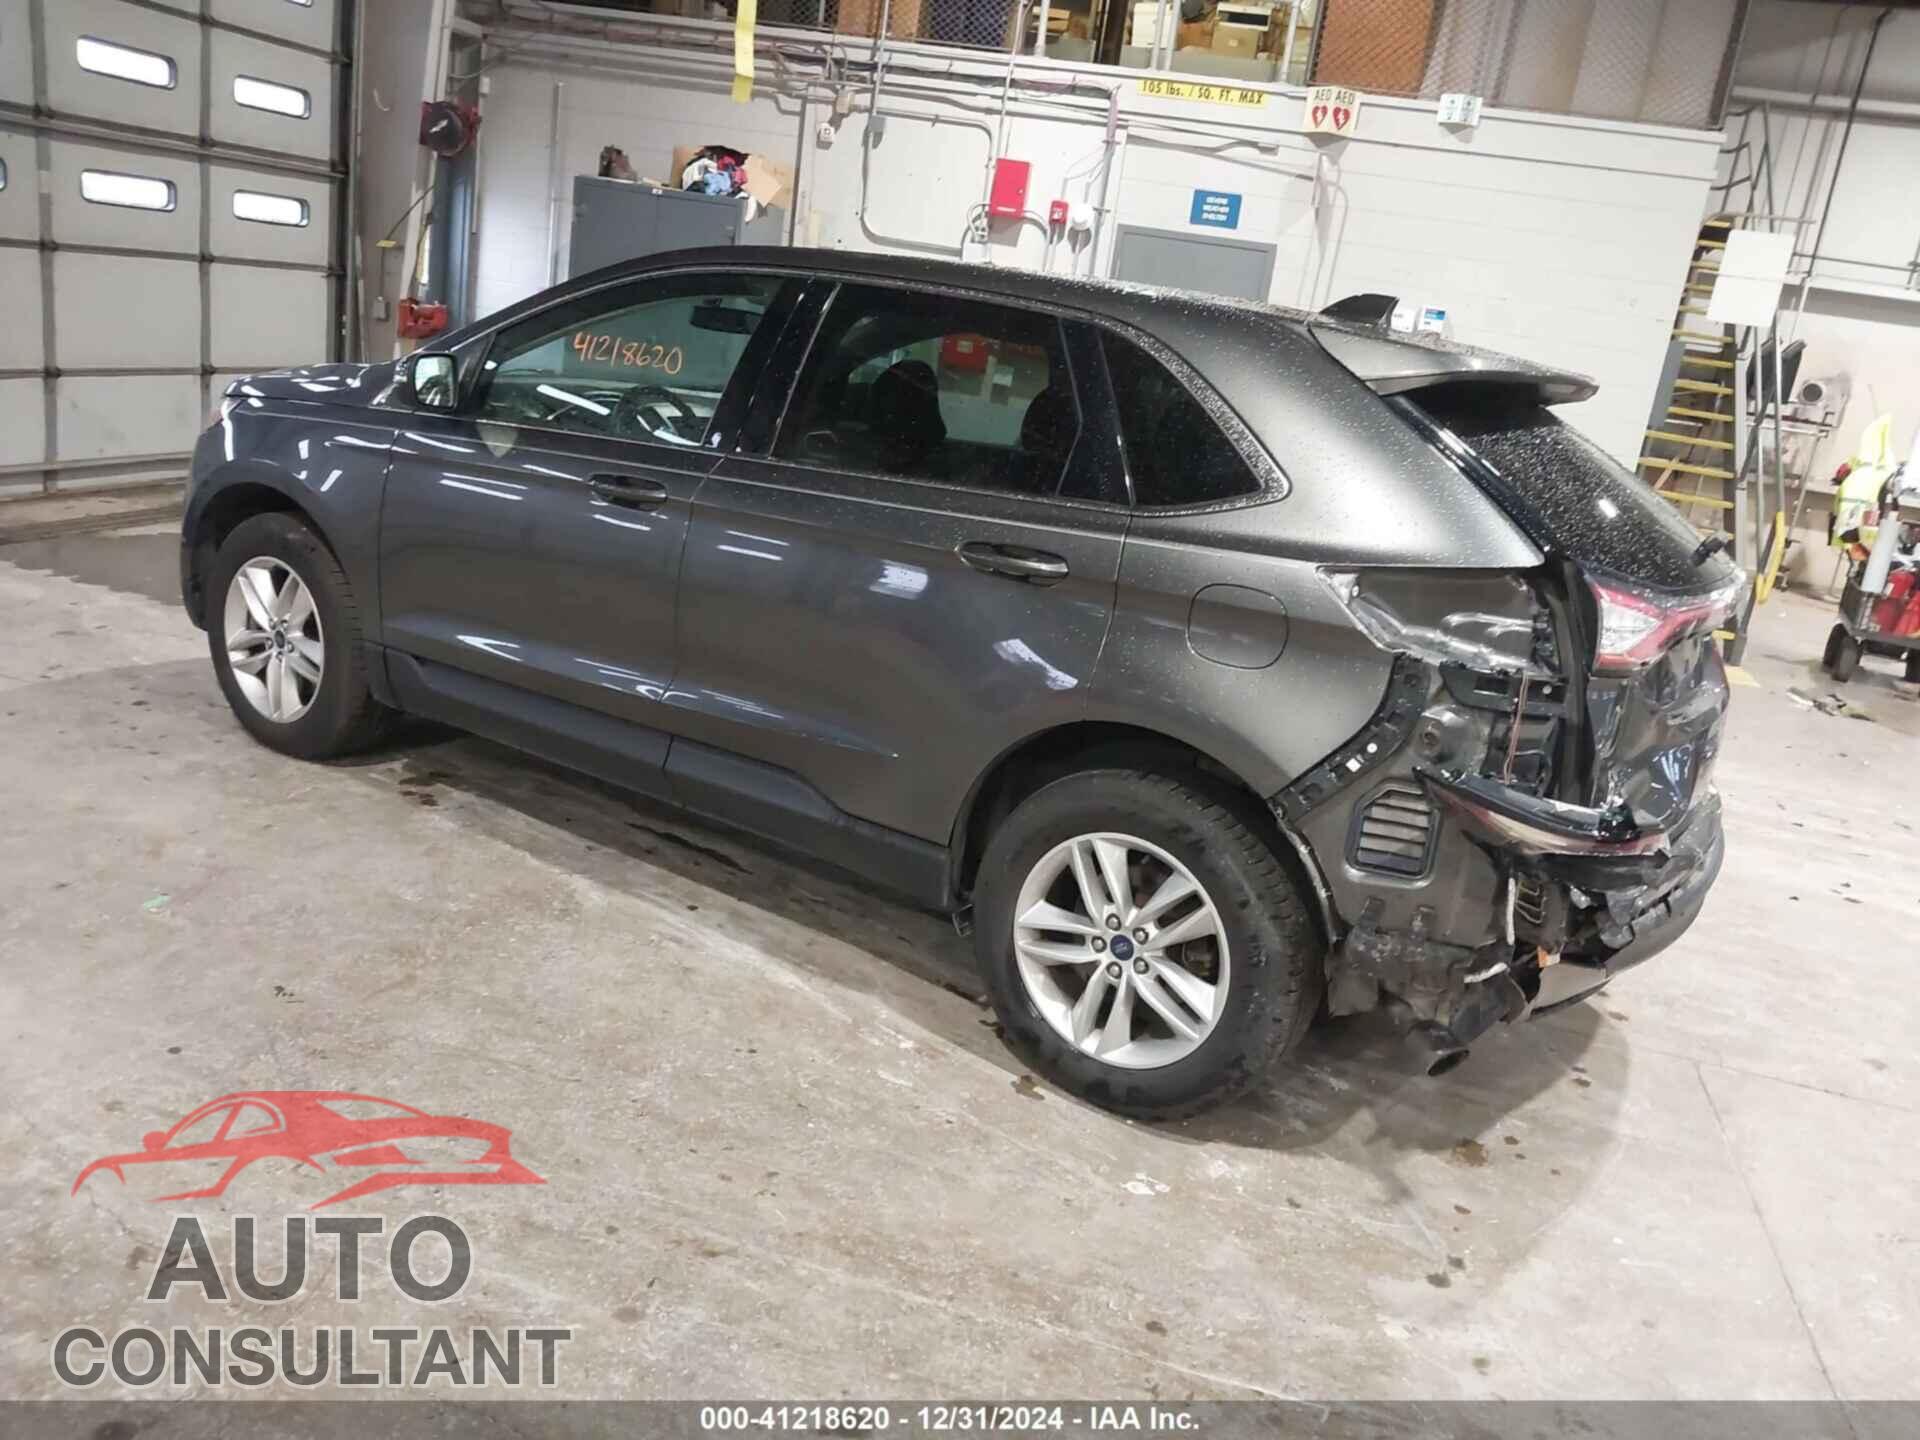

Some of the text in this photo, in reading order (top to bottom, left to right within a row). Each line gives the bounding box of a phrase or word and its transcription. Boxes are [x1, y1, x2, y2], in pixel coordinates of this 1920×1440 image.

[1142, 80, 1161, 94] 105
[1166, 80, 1184, 97] lbs.
[1198, 86, 1214, 100] SQ.
[1220, 88, 1234, 102] FT.
[1239, 90, 1264, 104] MAX
[1313, 88, 1331, 101] AED
[1334, 89, 1354, 105] AED
[574, 331, 682, 374] 41218620
